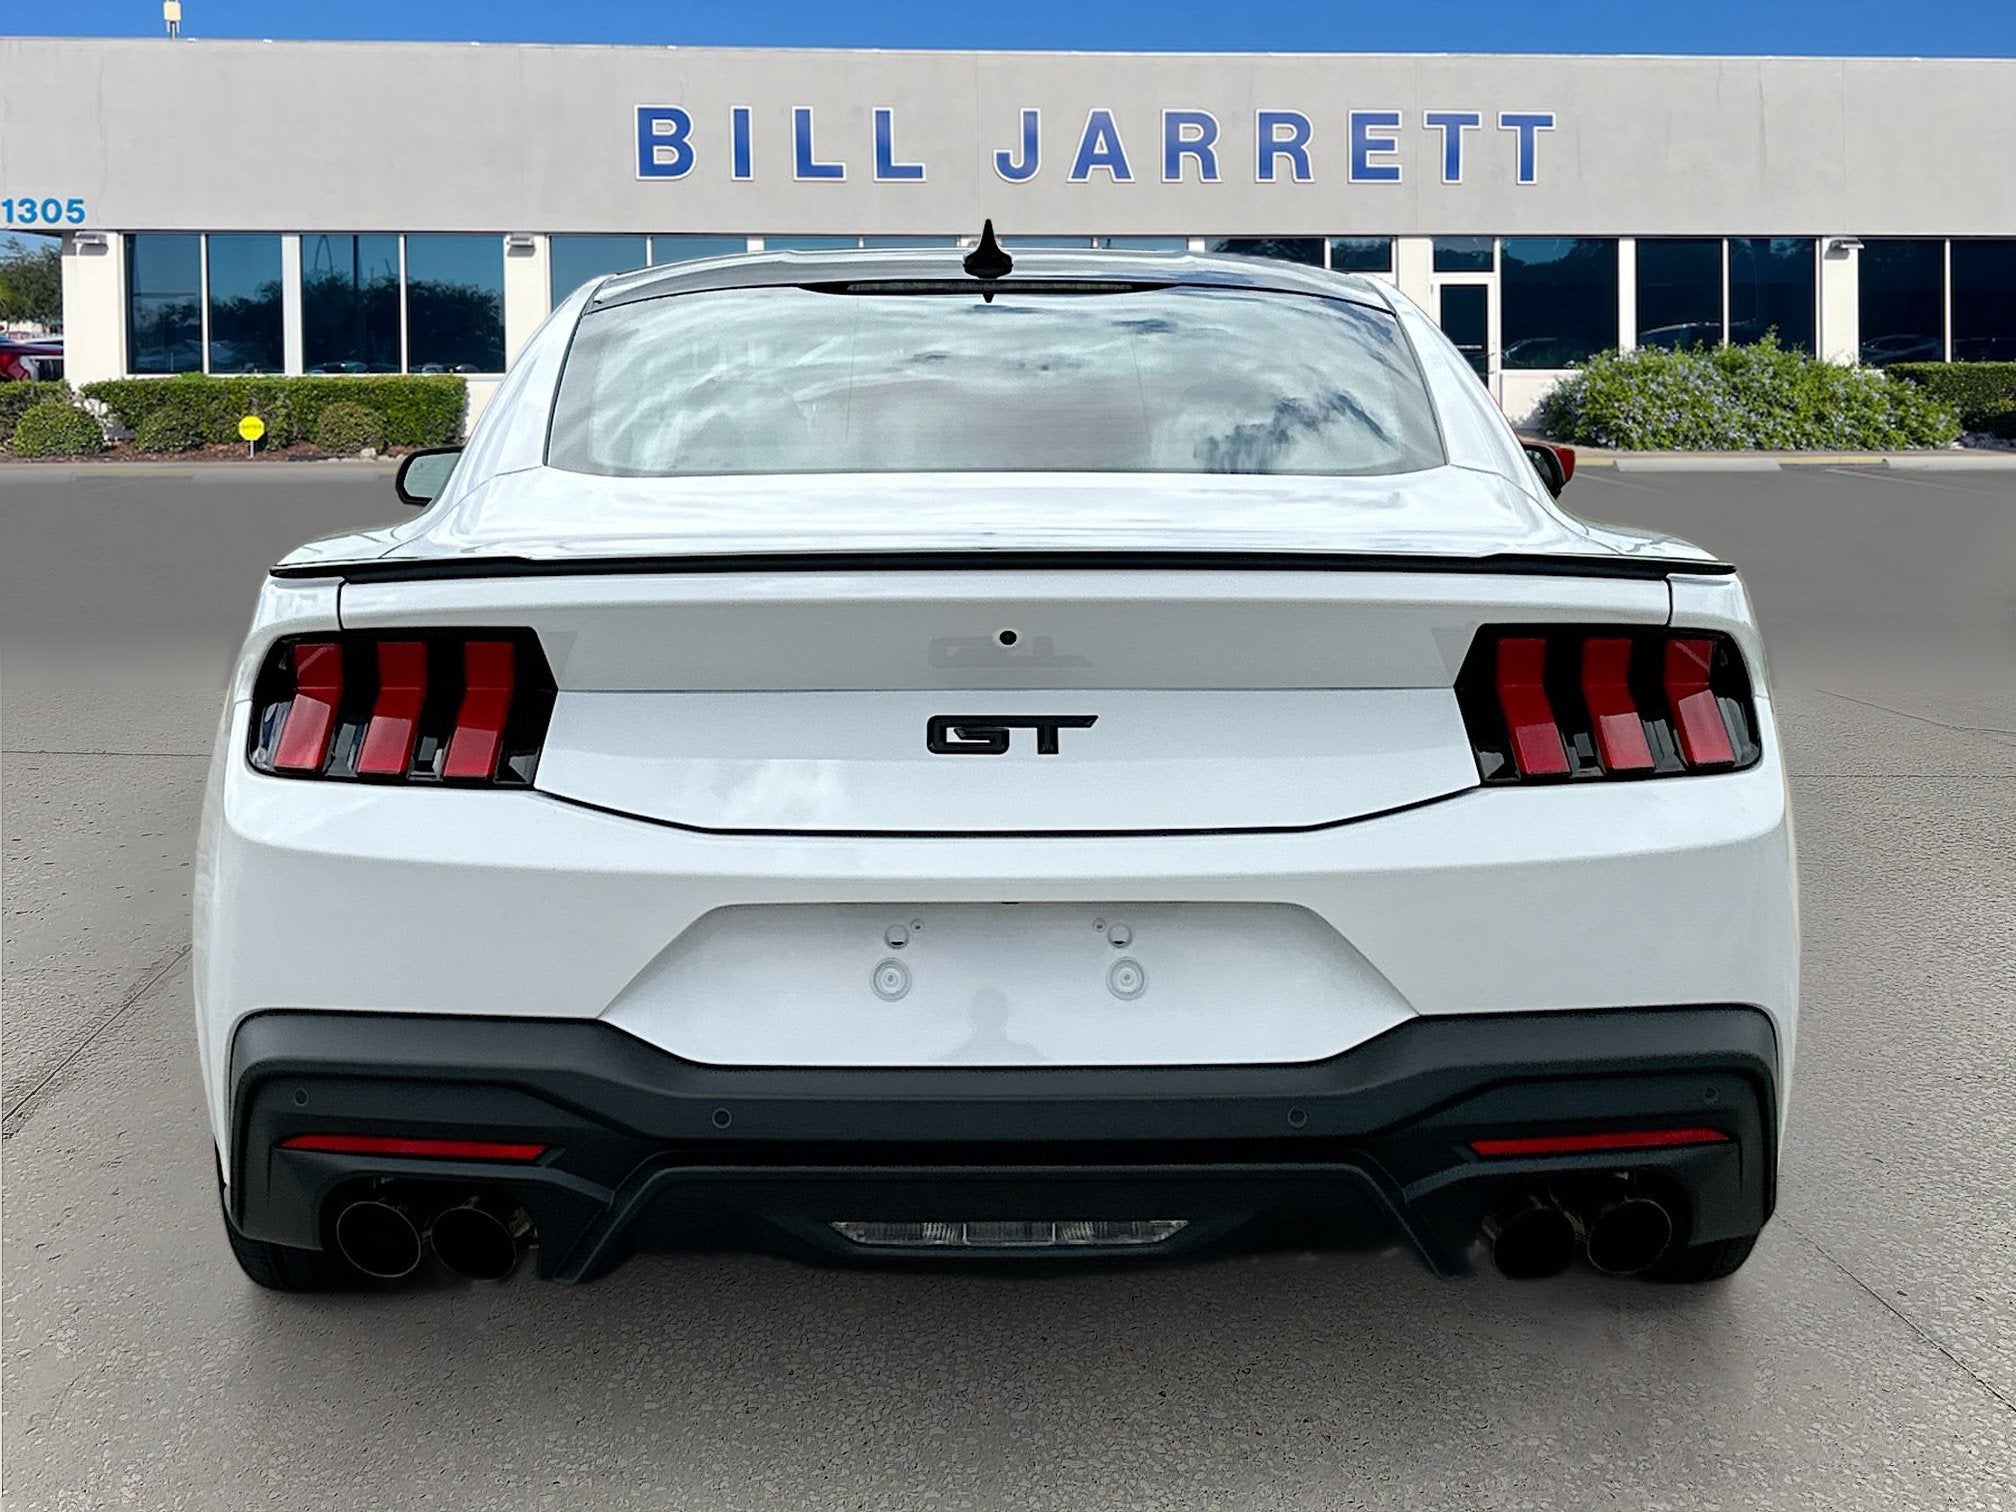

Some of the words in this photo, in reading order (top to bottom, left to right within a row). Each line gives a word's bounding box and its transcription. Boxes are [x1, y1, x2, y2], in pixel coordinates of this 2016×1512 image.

[634, 105, 926, 181] BILL
[993, 108, 1556, 185] JARRETT
[1, 198, 86, 224] 1305
[926, 714, 1099, 755] GT
